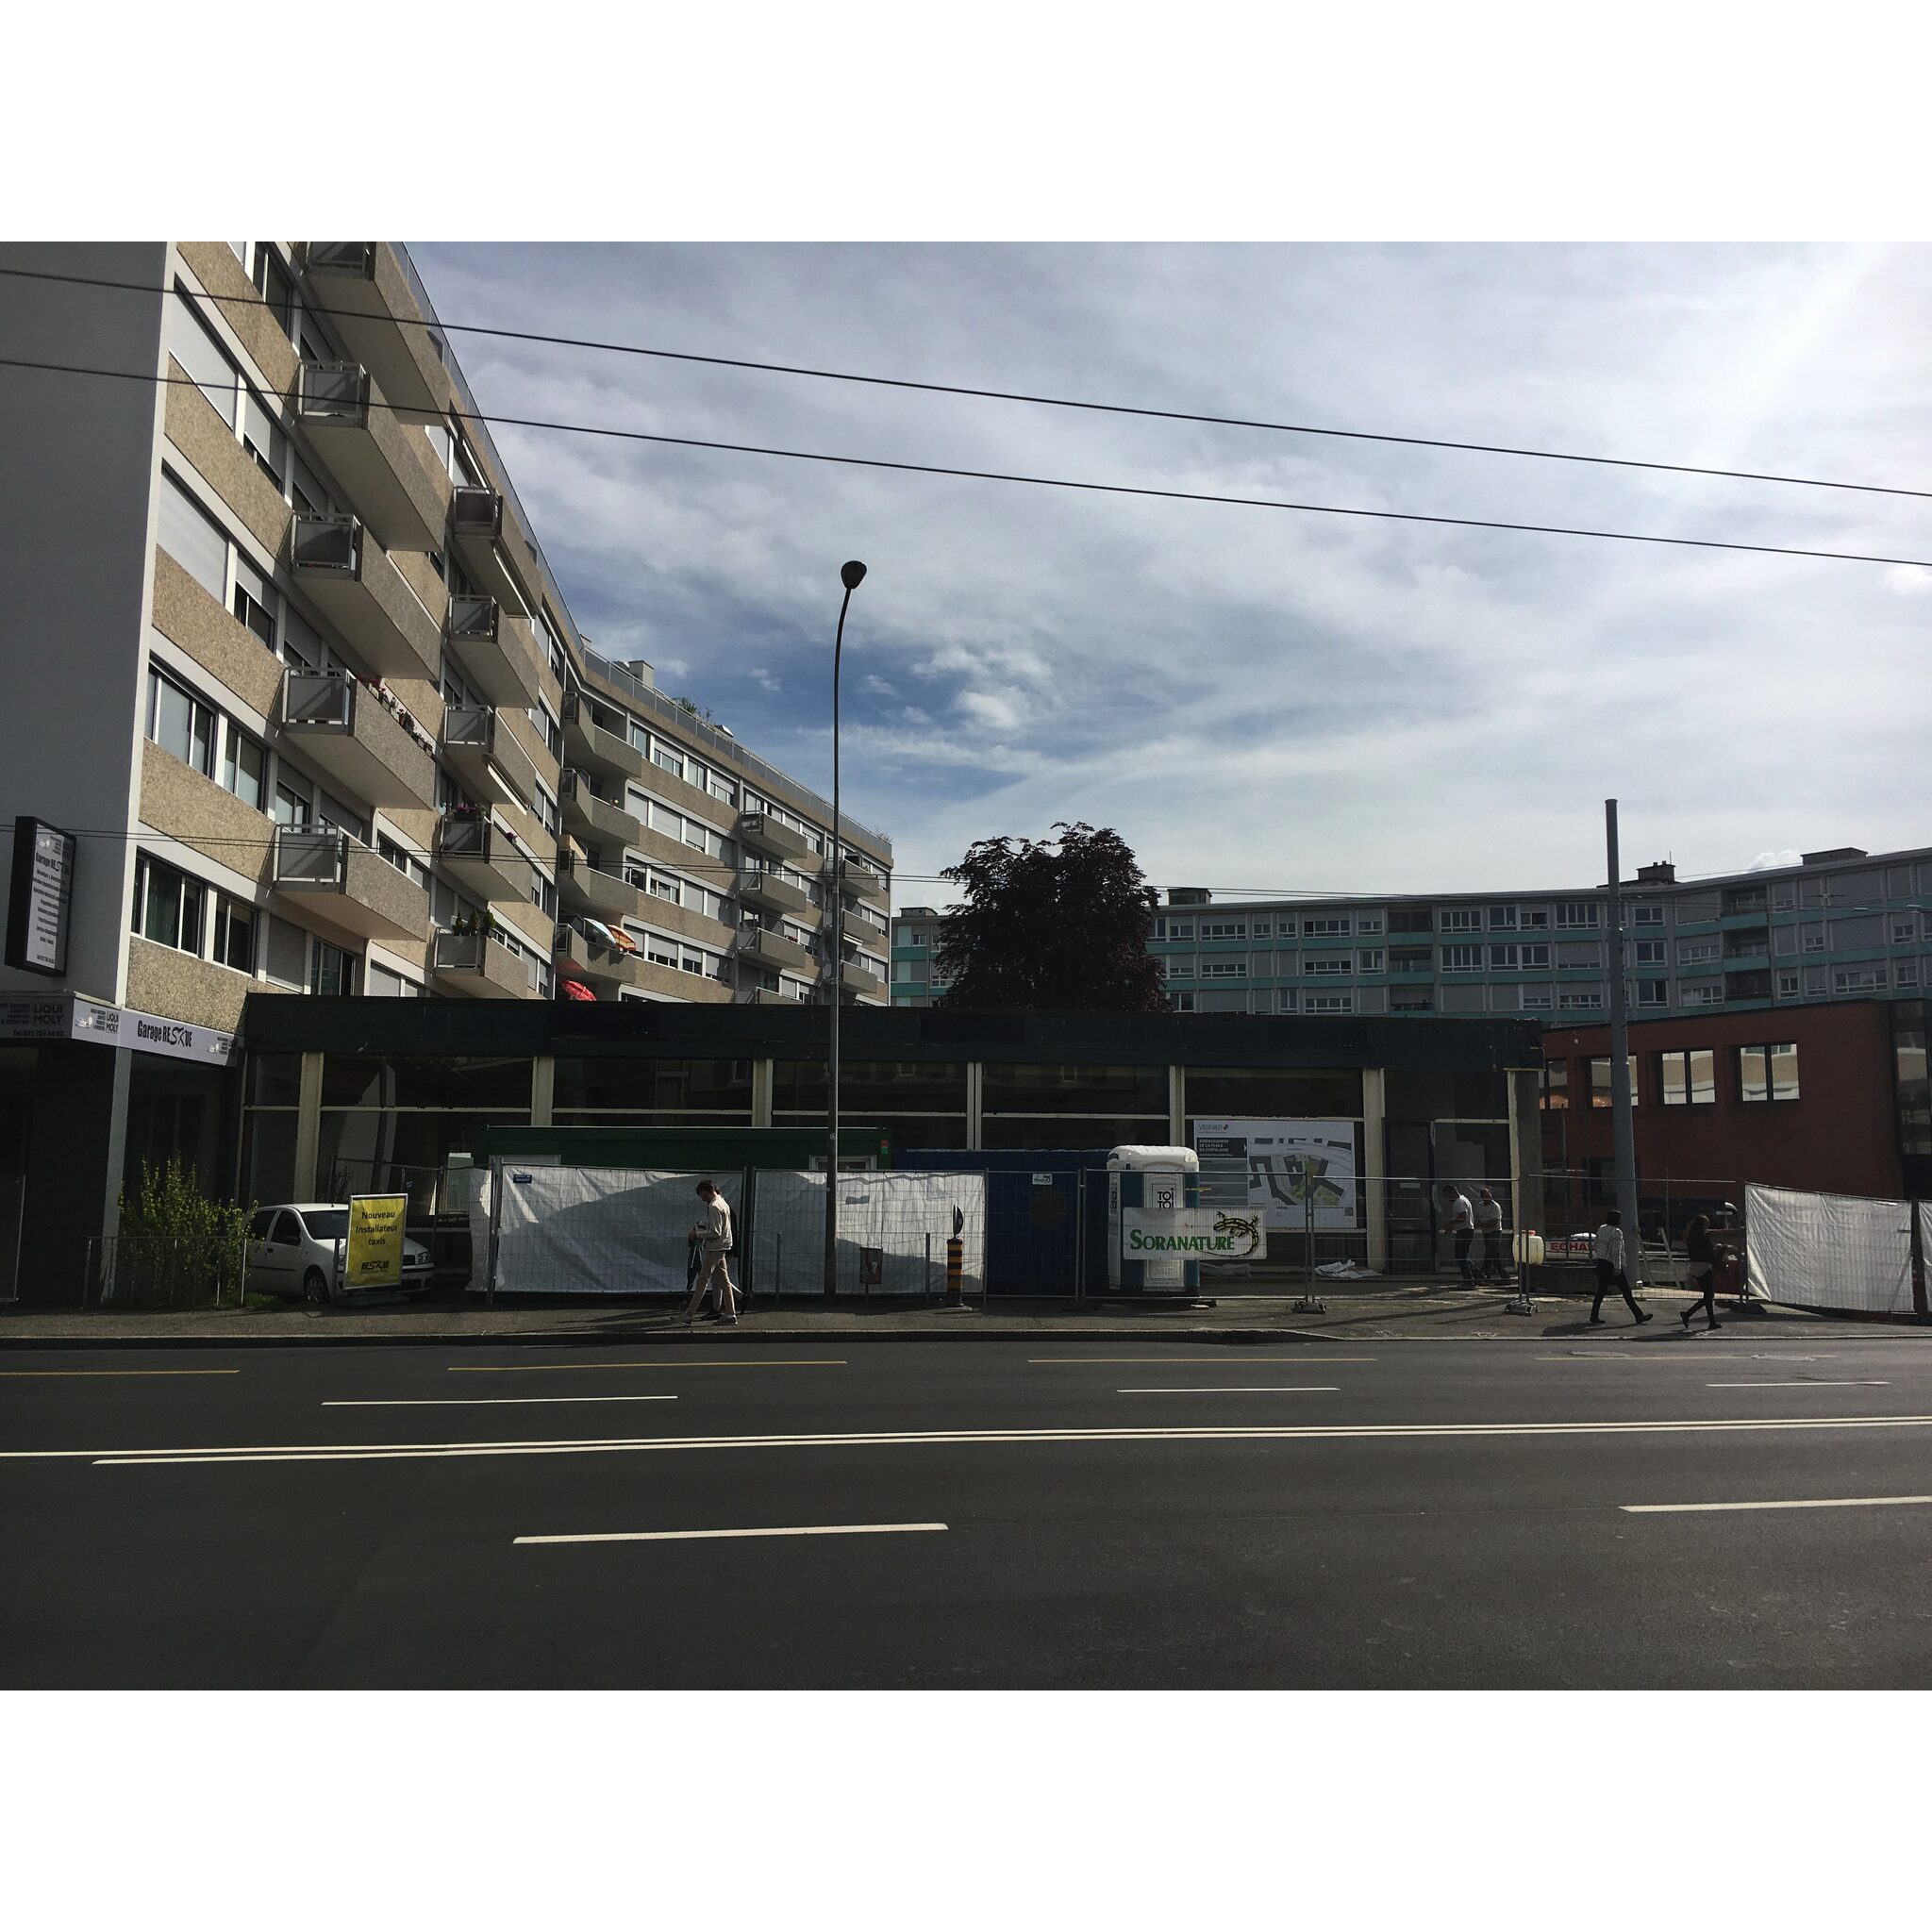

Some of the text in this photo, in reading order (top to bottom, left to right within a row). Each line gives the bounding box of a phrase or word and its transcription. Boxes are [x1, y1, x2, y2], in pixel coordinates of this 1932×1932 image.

[34, 1004, 63, 1014] LIQUI
[33, 1014, 63, 1024] MOLY
[107, 1011, 119, 1023] LIQUI
[106, 1023, 119, 1033] MOLY
[138, 1020, 162, 1041] Garage
[361, 1210, 395, 1220] Nouveau
[356, 1224, 398, 1234] Installateur
[368, 1237, 387, 1246] taxis
[1130, 1229, 1235, 1251] SORANATURE
